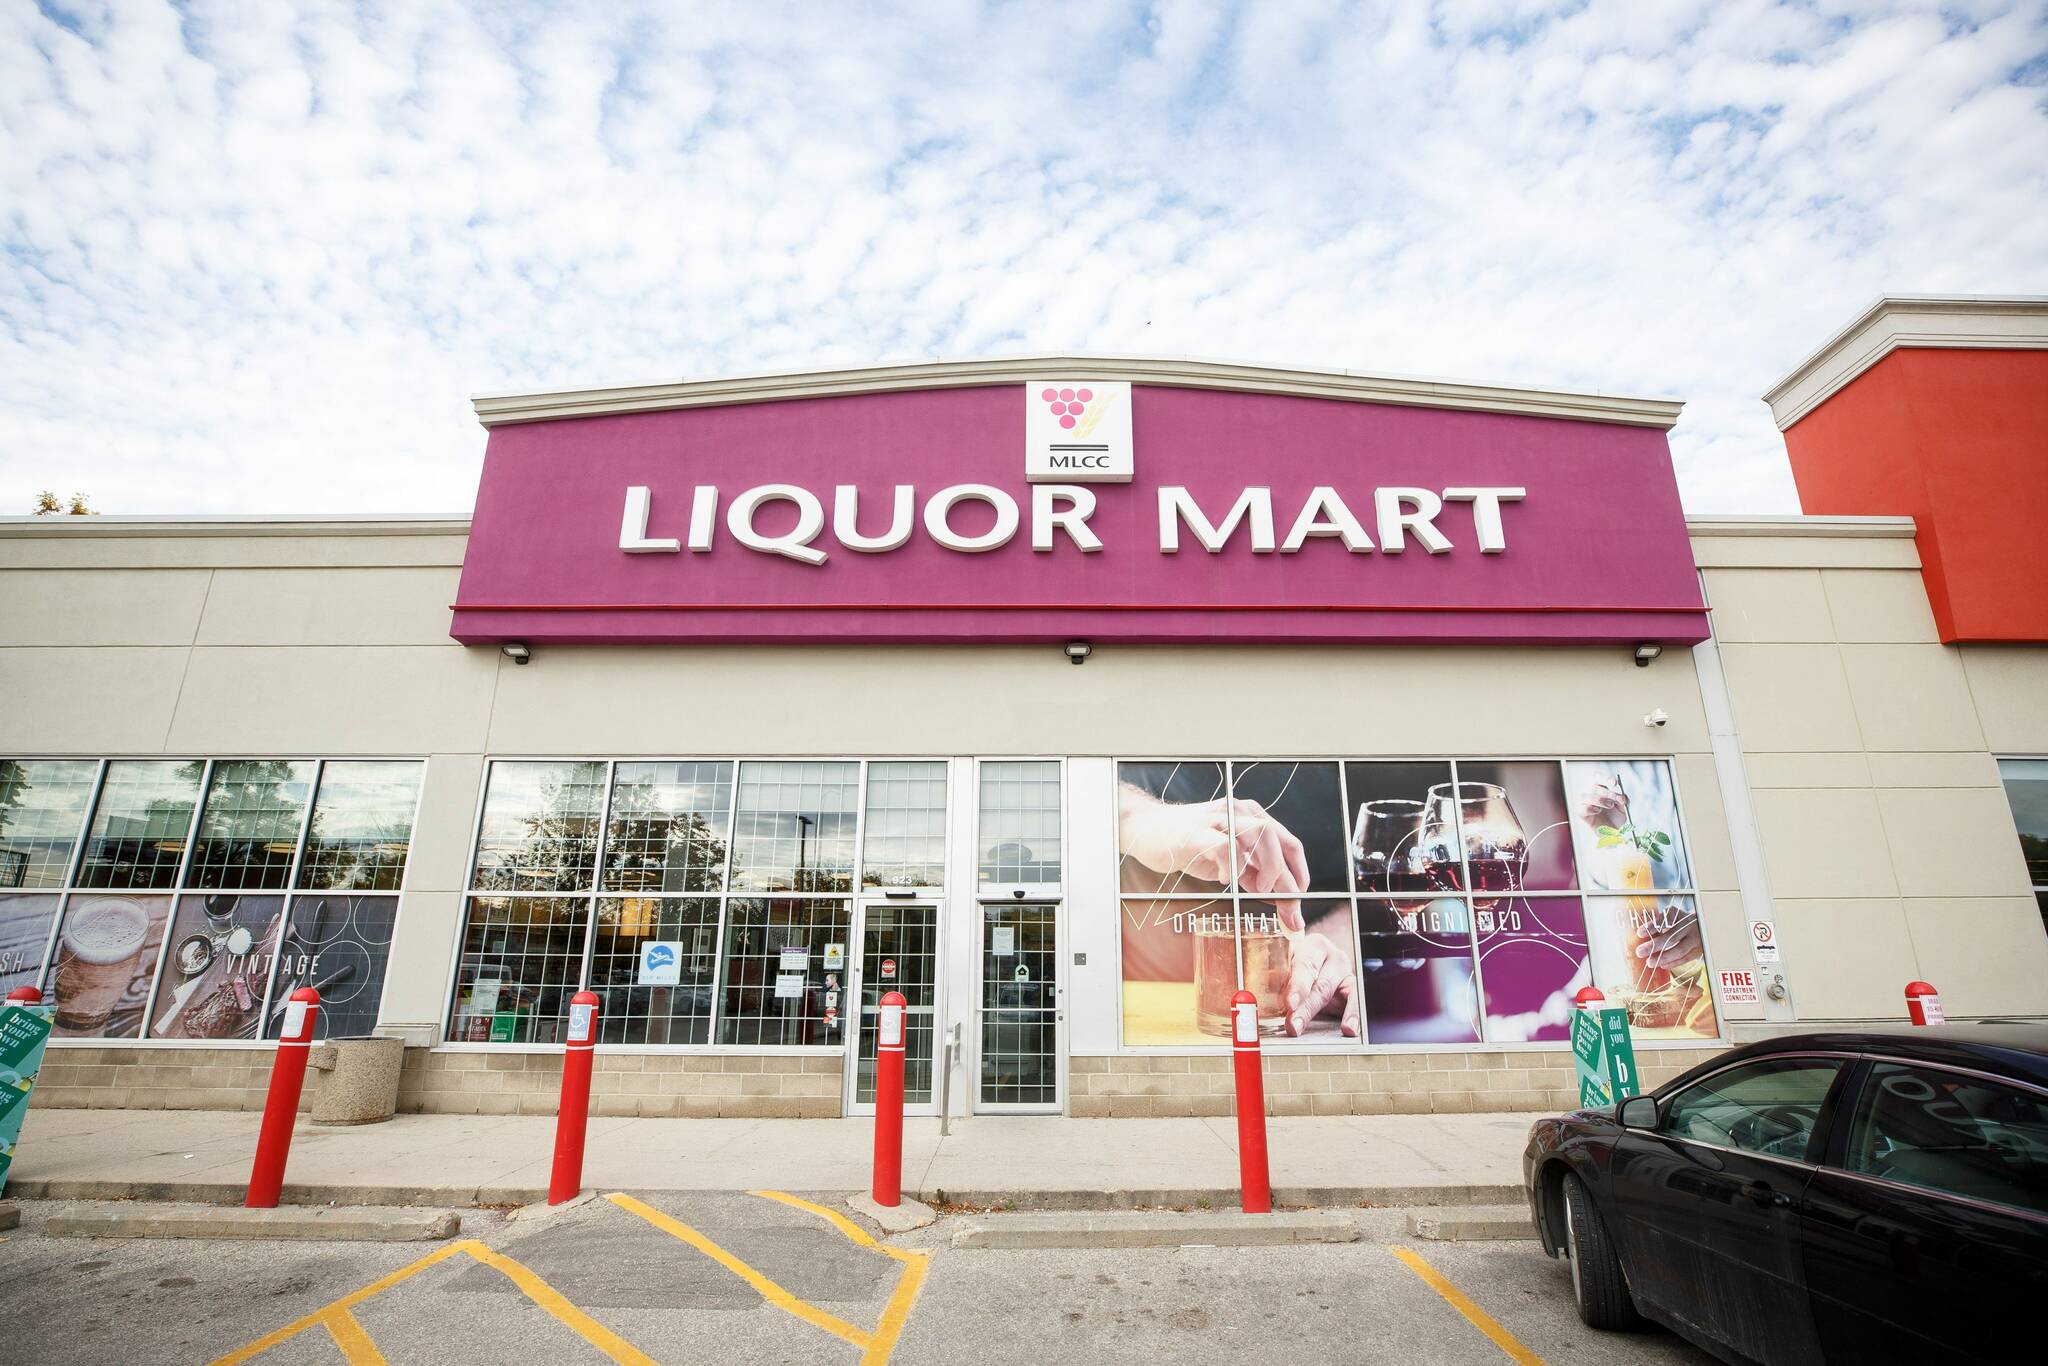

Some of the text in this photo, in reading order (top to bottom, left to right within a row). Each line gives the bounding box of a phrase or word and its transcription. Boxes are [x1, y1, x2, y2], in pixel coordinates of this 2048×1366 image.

[1049, 455, 1110, 468] MLCC
[618, 483, 1527, 566] LIQUOR MART
[892, 875, 912, 885] 923
[1173, 912, 1281, 934] ORIGINAL
[1616, 908, 1674, 929] CHILL
[226, 953, 320, 976] VINTAGE
[1721, 972, 1753, 986] FIRE
[0, 1023, 31, 1040] your
[9, 1012, 43, 1035] bring
[1580, 1015, 1599, 1040] bring
[1608, 1015, 1622, 1030] did
[1578, 1025, 1593, 1043] your
[1610, 1032, 1625, 1047] you
